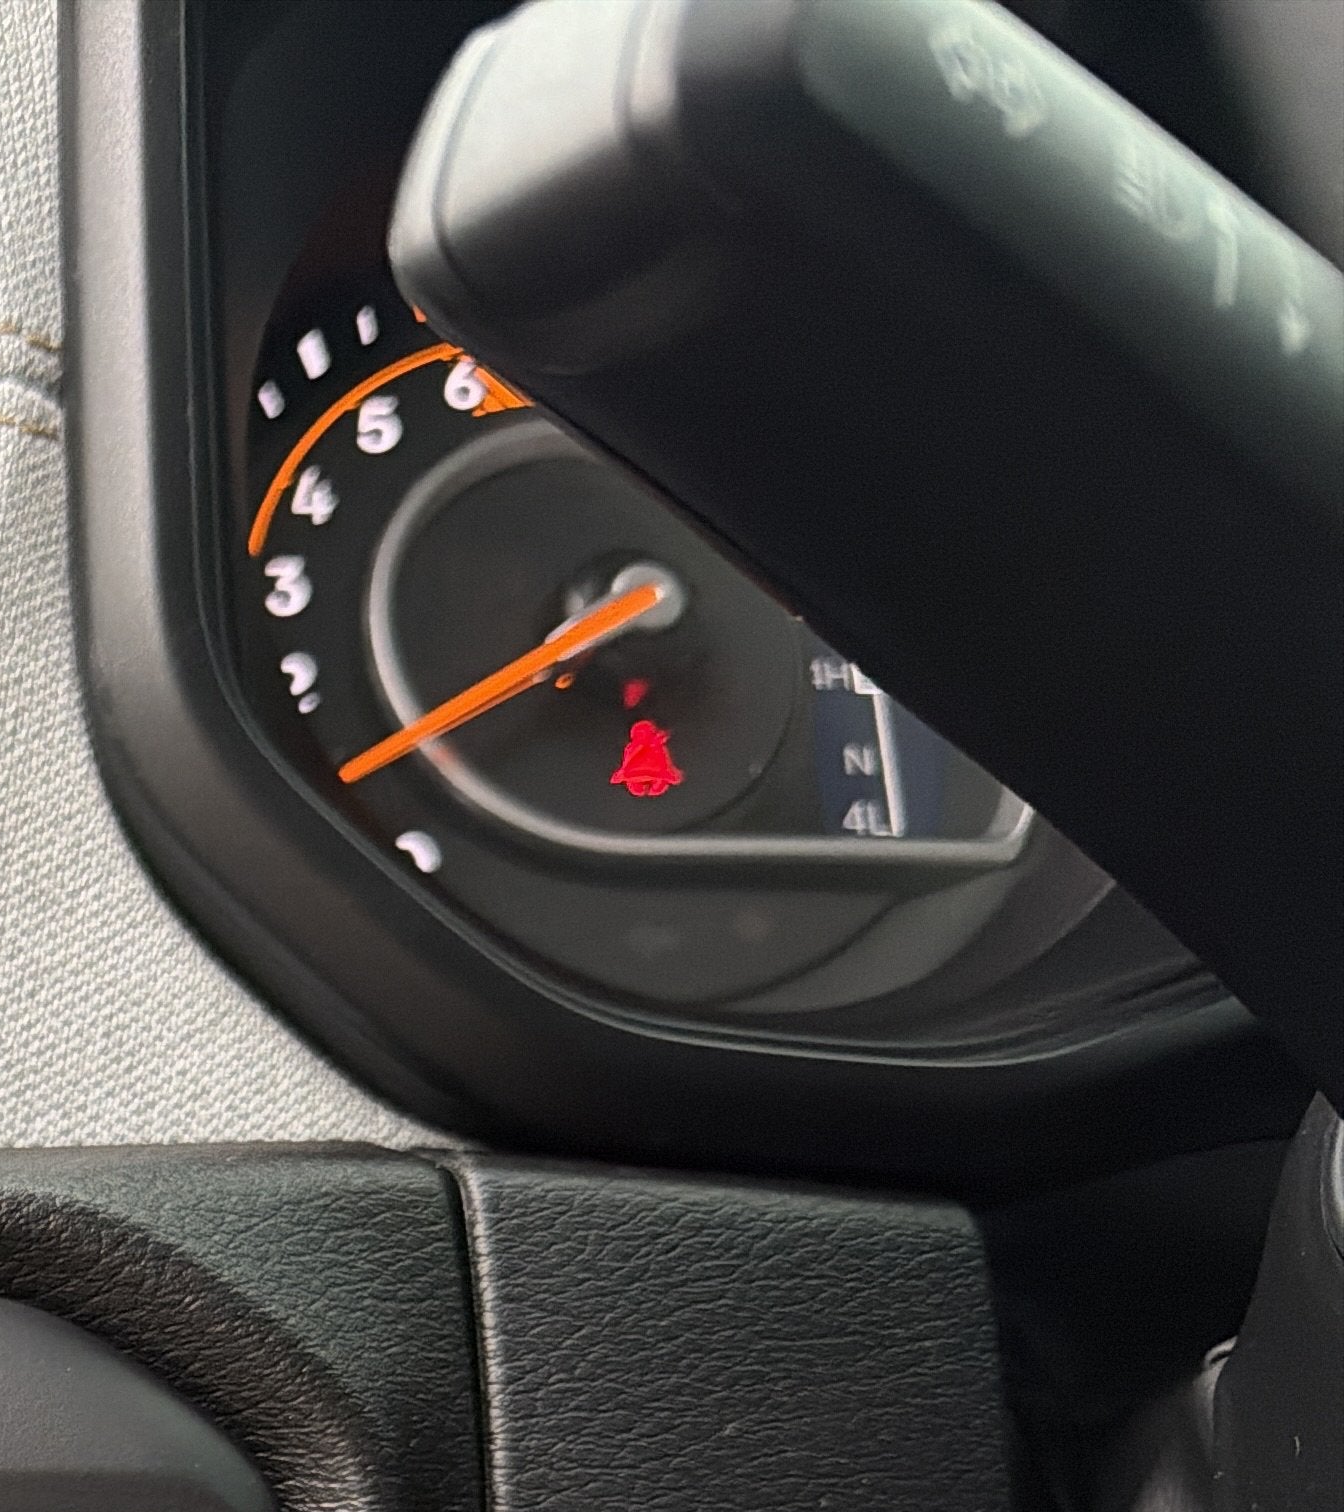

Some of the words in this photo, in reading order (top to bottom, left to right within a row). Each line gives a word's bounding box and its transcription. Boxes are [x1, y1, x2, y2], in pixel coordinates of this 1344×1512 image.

[444, 355, 488, 411] 6
[356, 395, 403, 455] 5
[291, 465, 340, 526] 4
[265, 554, 312, 617] 3
